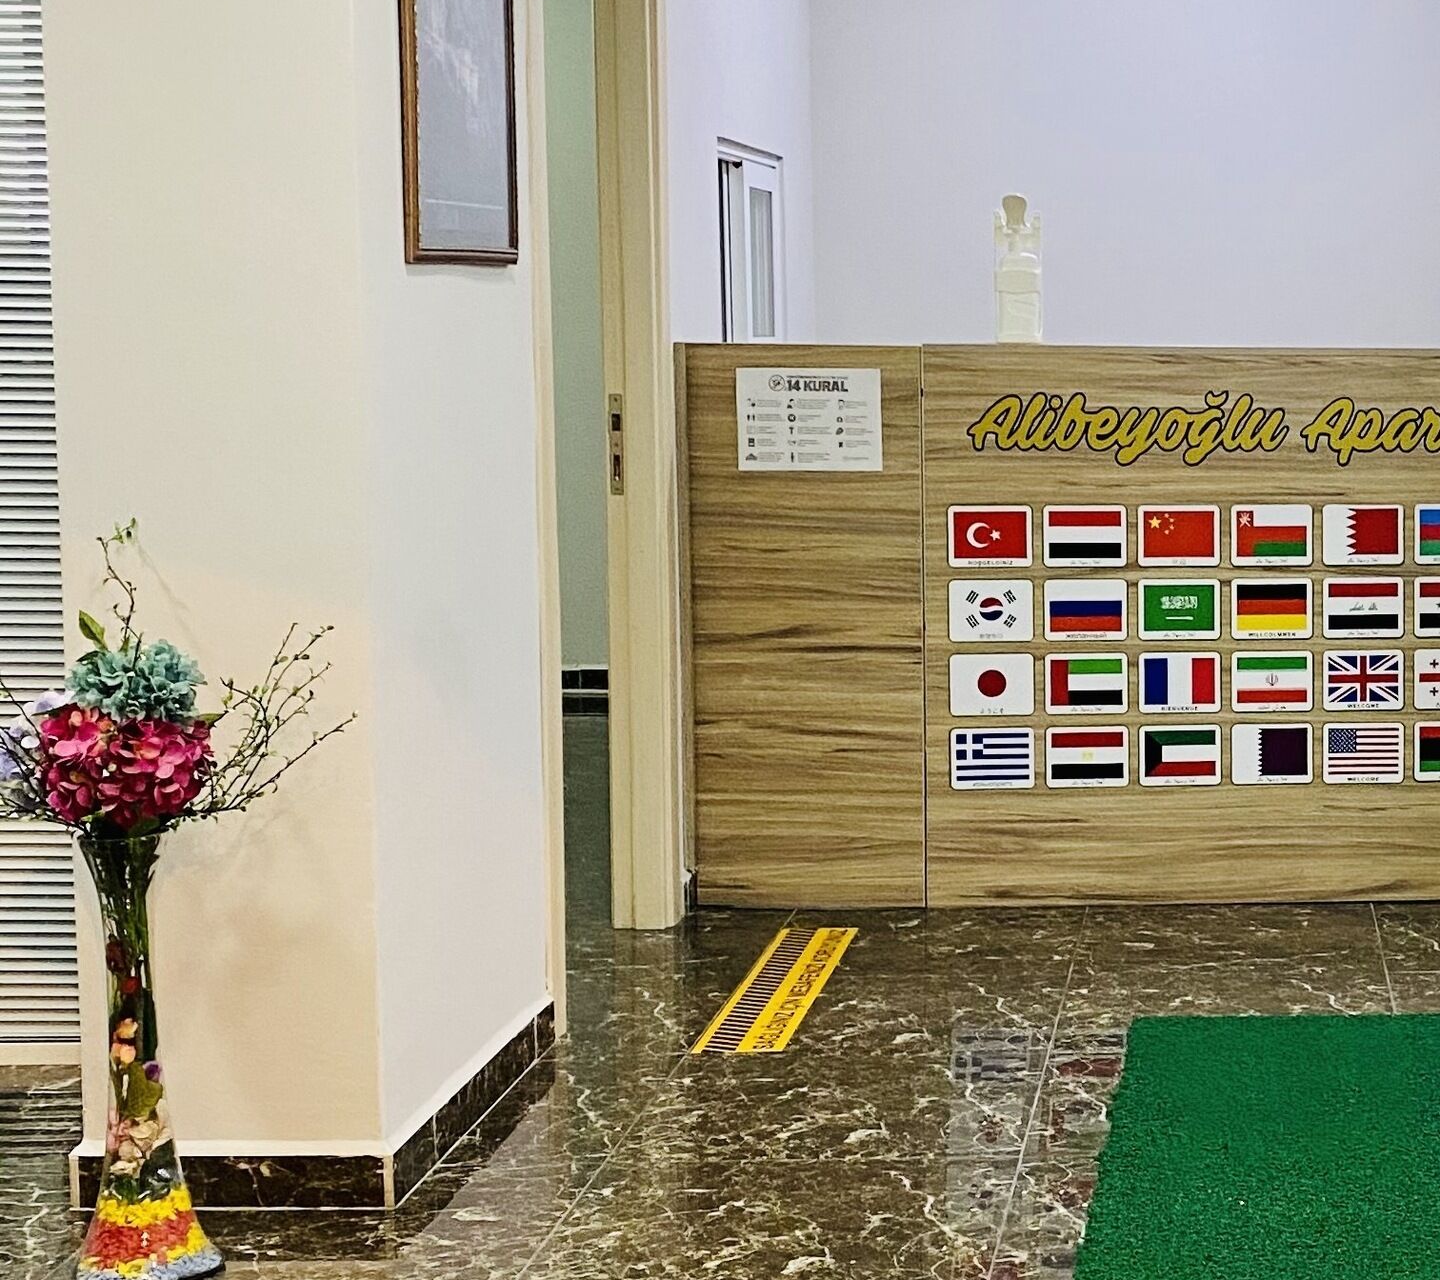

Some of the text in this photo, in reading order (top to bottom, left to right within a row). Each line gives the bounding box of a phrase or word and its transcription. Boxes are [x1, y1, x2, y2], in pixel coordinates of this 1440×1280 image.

[787, 379, 849, 392] 14 KURAL
[966, 390, 1290, 467] Alibeyoğlu
